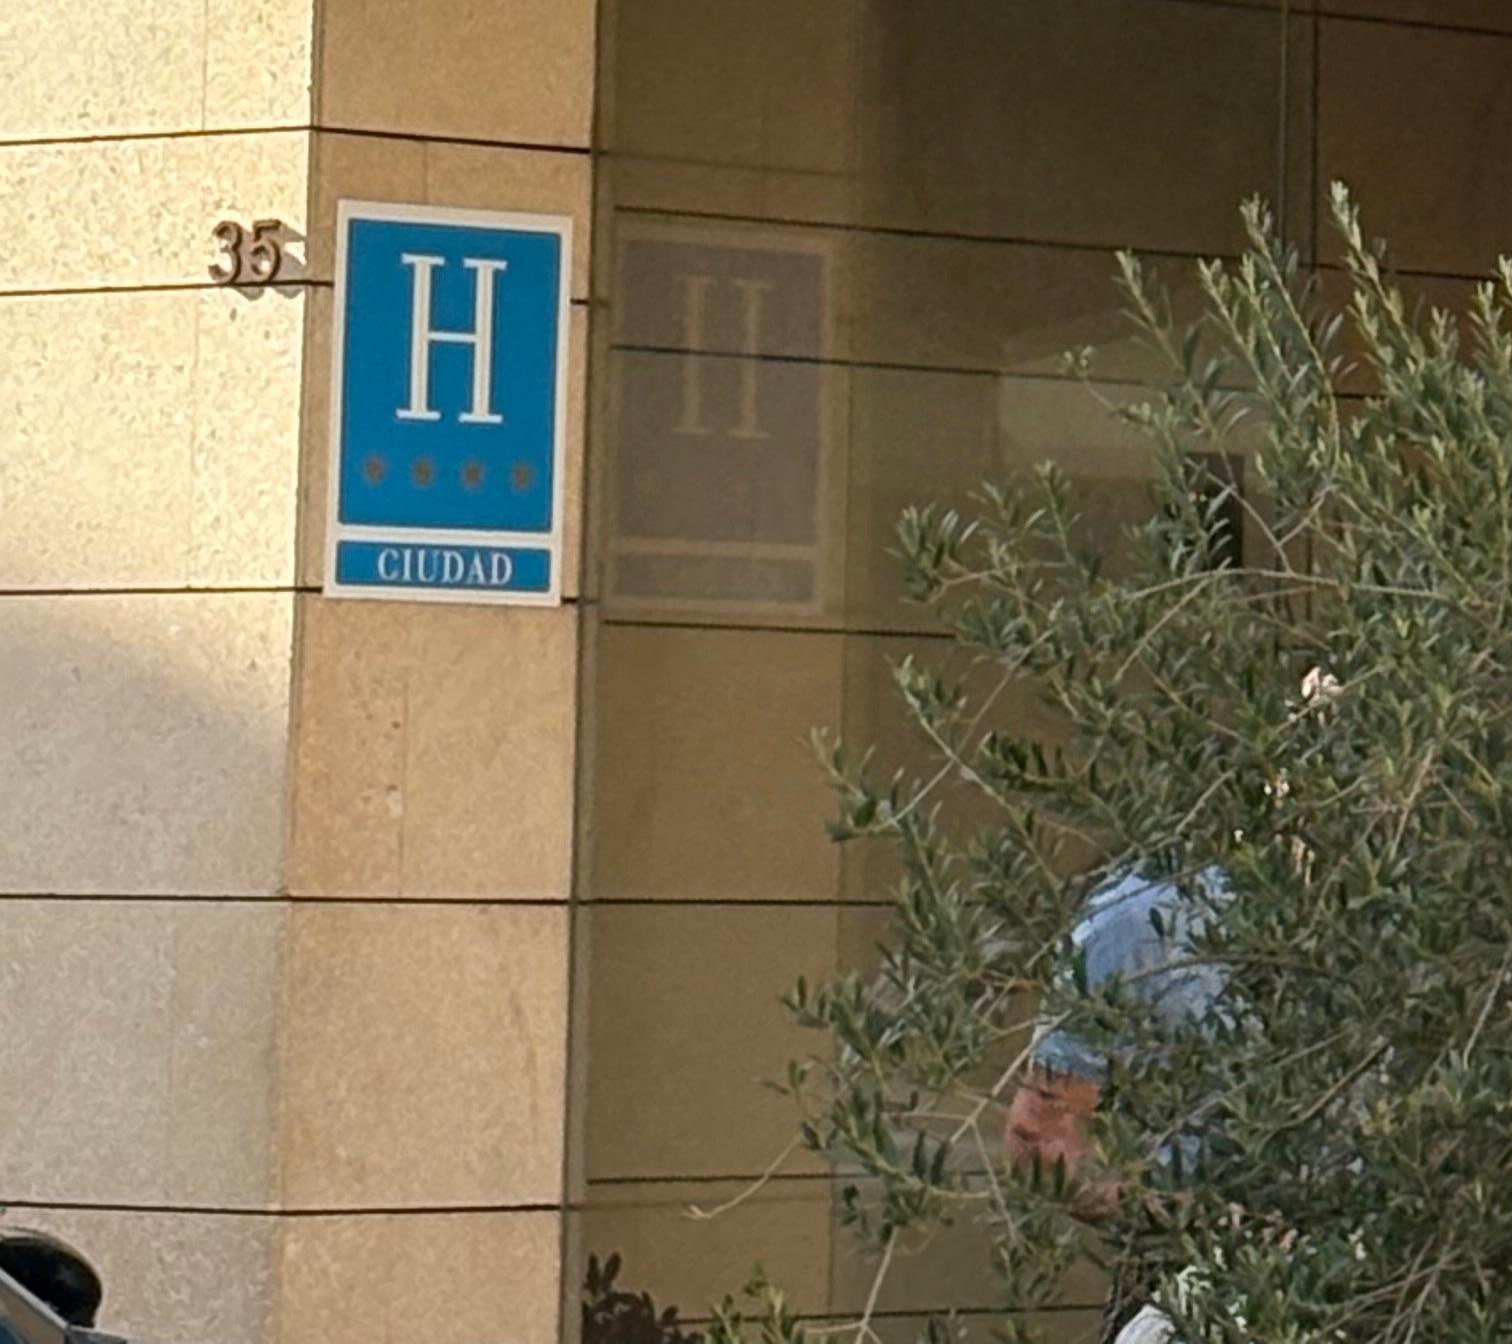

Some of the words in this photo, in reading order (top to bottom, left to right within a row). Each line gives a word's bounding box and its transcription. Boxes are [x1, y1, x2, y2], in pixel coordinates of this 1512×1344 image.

[207, 219, 283, 285] 35
[395, 252, 507, 425] H
[376, 547, 513, 588] CIUDAD
